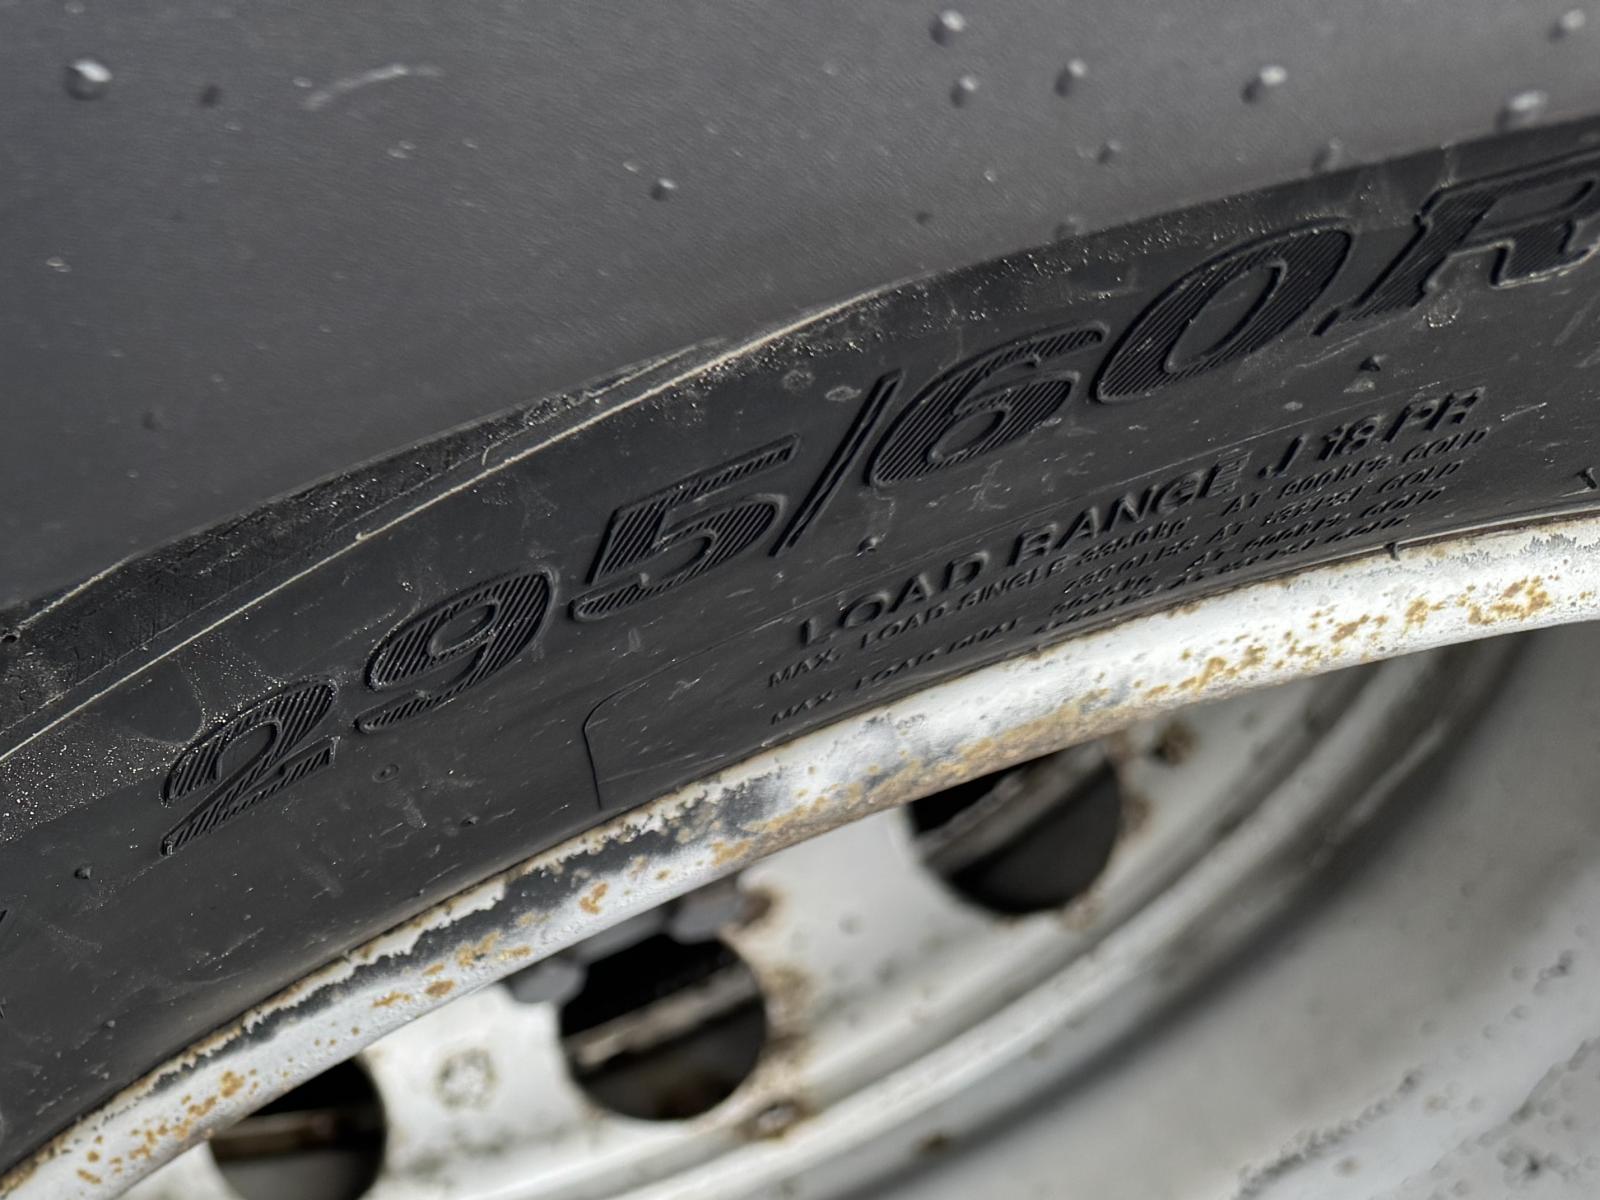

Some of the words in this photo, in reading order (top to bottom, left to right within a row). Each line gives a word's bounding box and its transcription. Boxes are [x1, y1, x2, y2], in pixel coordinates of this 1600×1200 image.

[767, 646, 843, 688] MAX.
[859, 604, 948, 650] LOAD
[954, 557, 1069, 611] SINGLE
[1221, 484, 1274, 518] AT
[1400, 424, 1494, 464] COLD
[799, 550, 992, 648] LOAD
[1006, 446, 1252, 569] RANGE
[1257, 432, 1310, 480] J
[1316, 412, 1387, 462] 18
[1377, 457, 1468, 495] COLD
